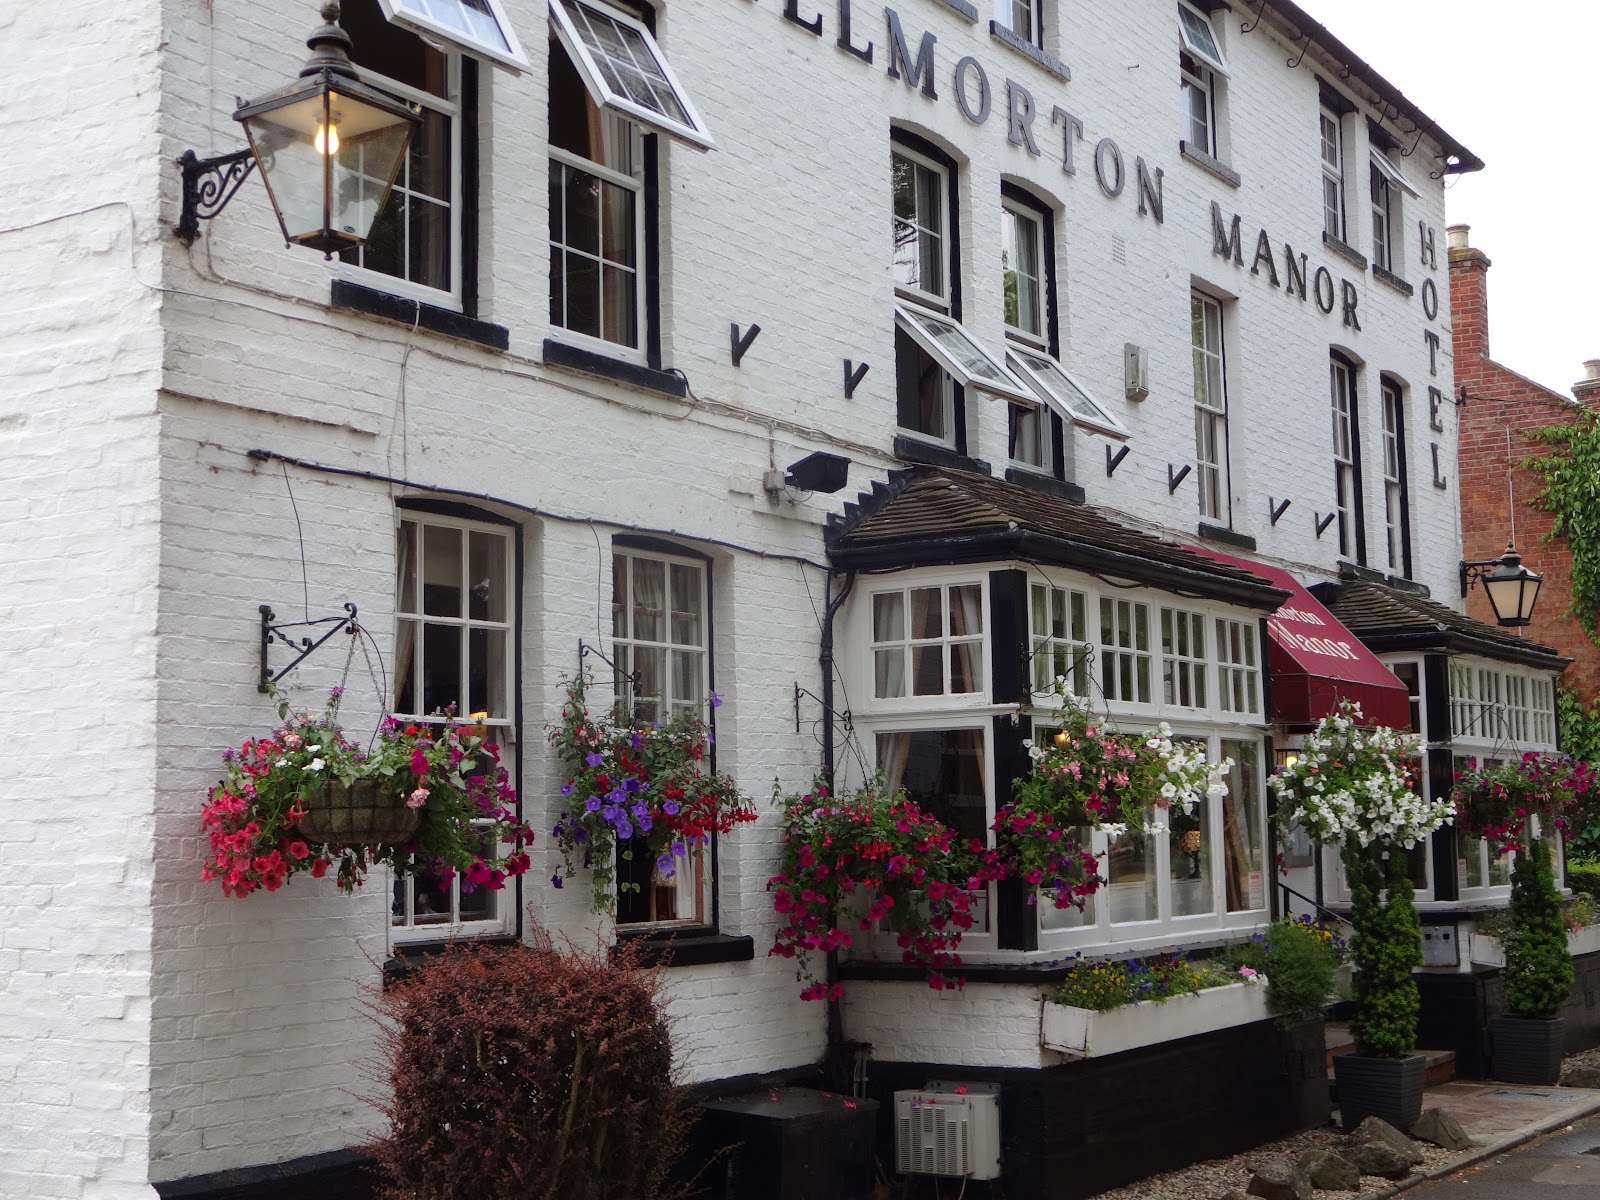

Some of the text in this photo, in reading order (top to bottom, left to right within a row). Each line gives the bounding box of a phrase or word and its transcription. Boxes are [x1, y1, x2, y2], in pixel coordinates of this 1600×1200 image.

[1210, 200, 1361, 332] MANOR
[1419, 220, 1446, 490] HOTEL
[1267, 619, 1359, 660] Manor
